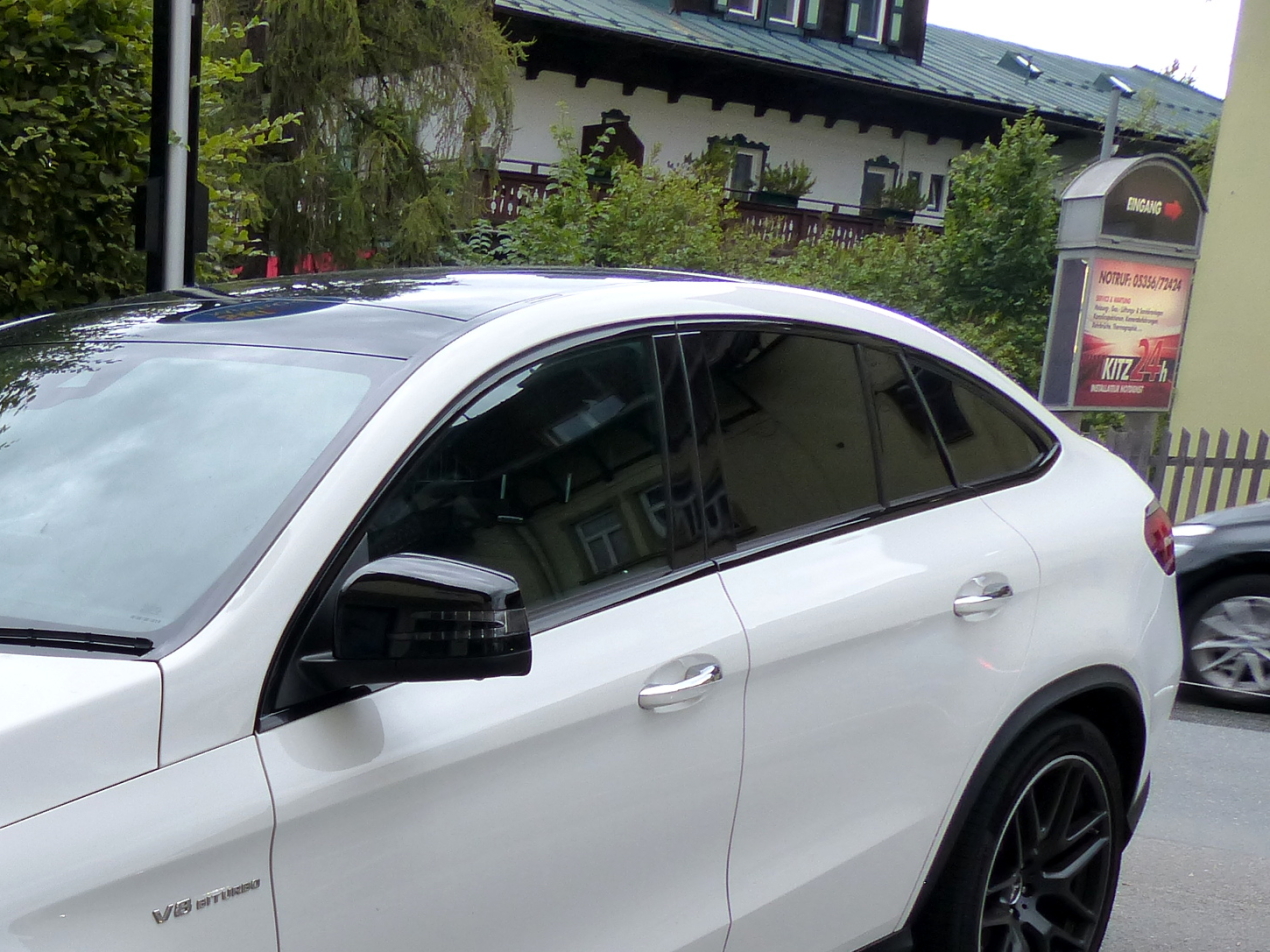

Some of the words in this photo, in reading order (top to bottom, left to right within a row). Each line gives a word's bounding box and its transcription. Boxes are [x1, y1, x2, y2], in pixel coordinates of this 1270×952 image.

[1126, 196, 1162, 216] EINGANG
[1098, 270, 1132, 287] NOTRUF:
[1132, 274, 1182, 292] 05356/72424
[151, 898, 193, 925] V8
[195, 878, 261, 911] BITURBO
